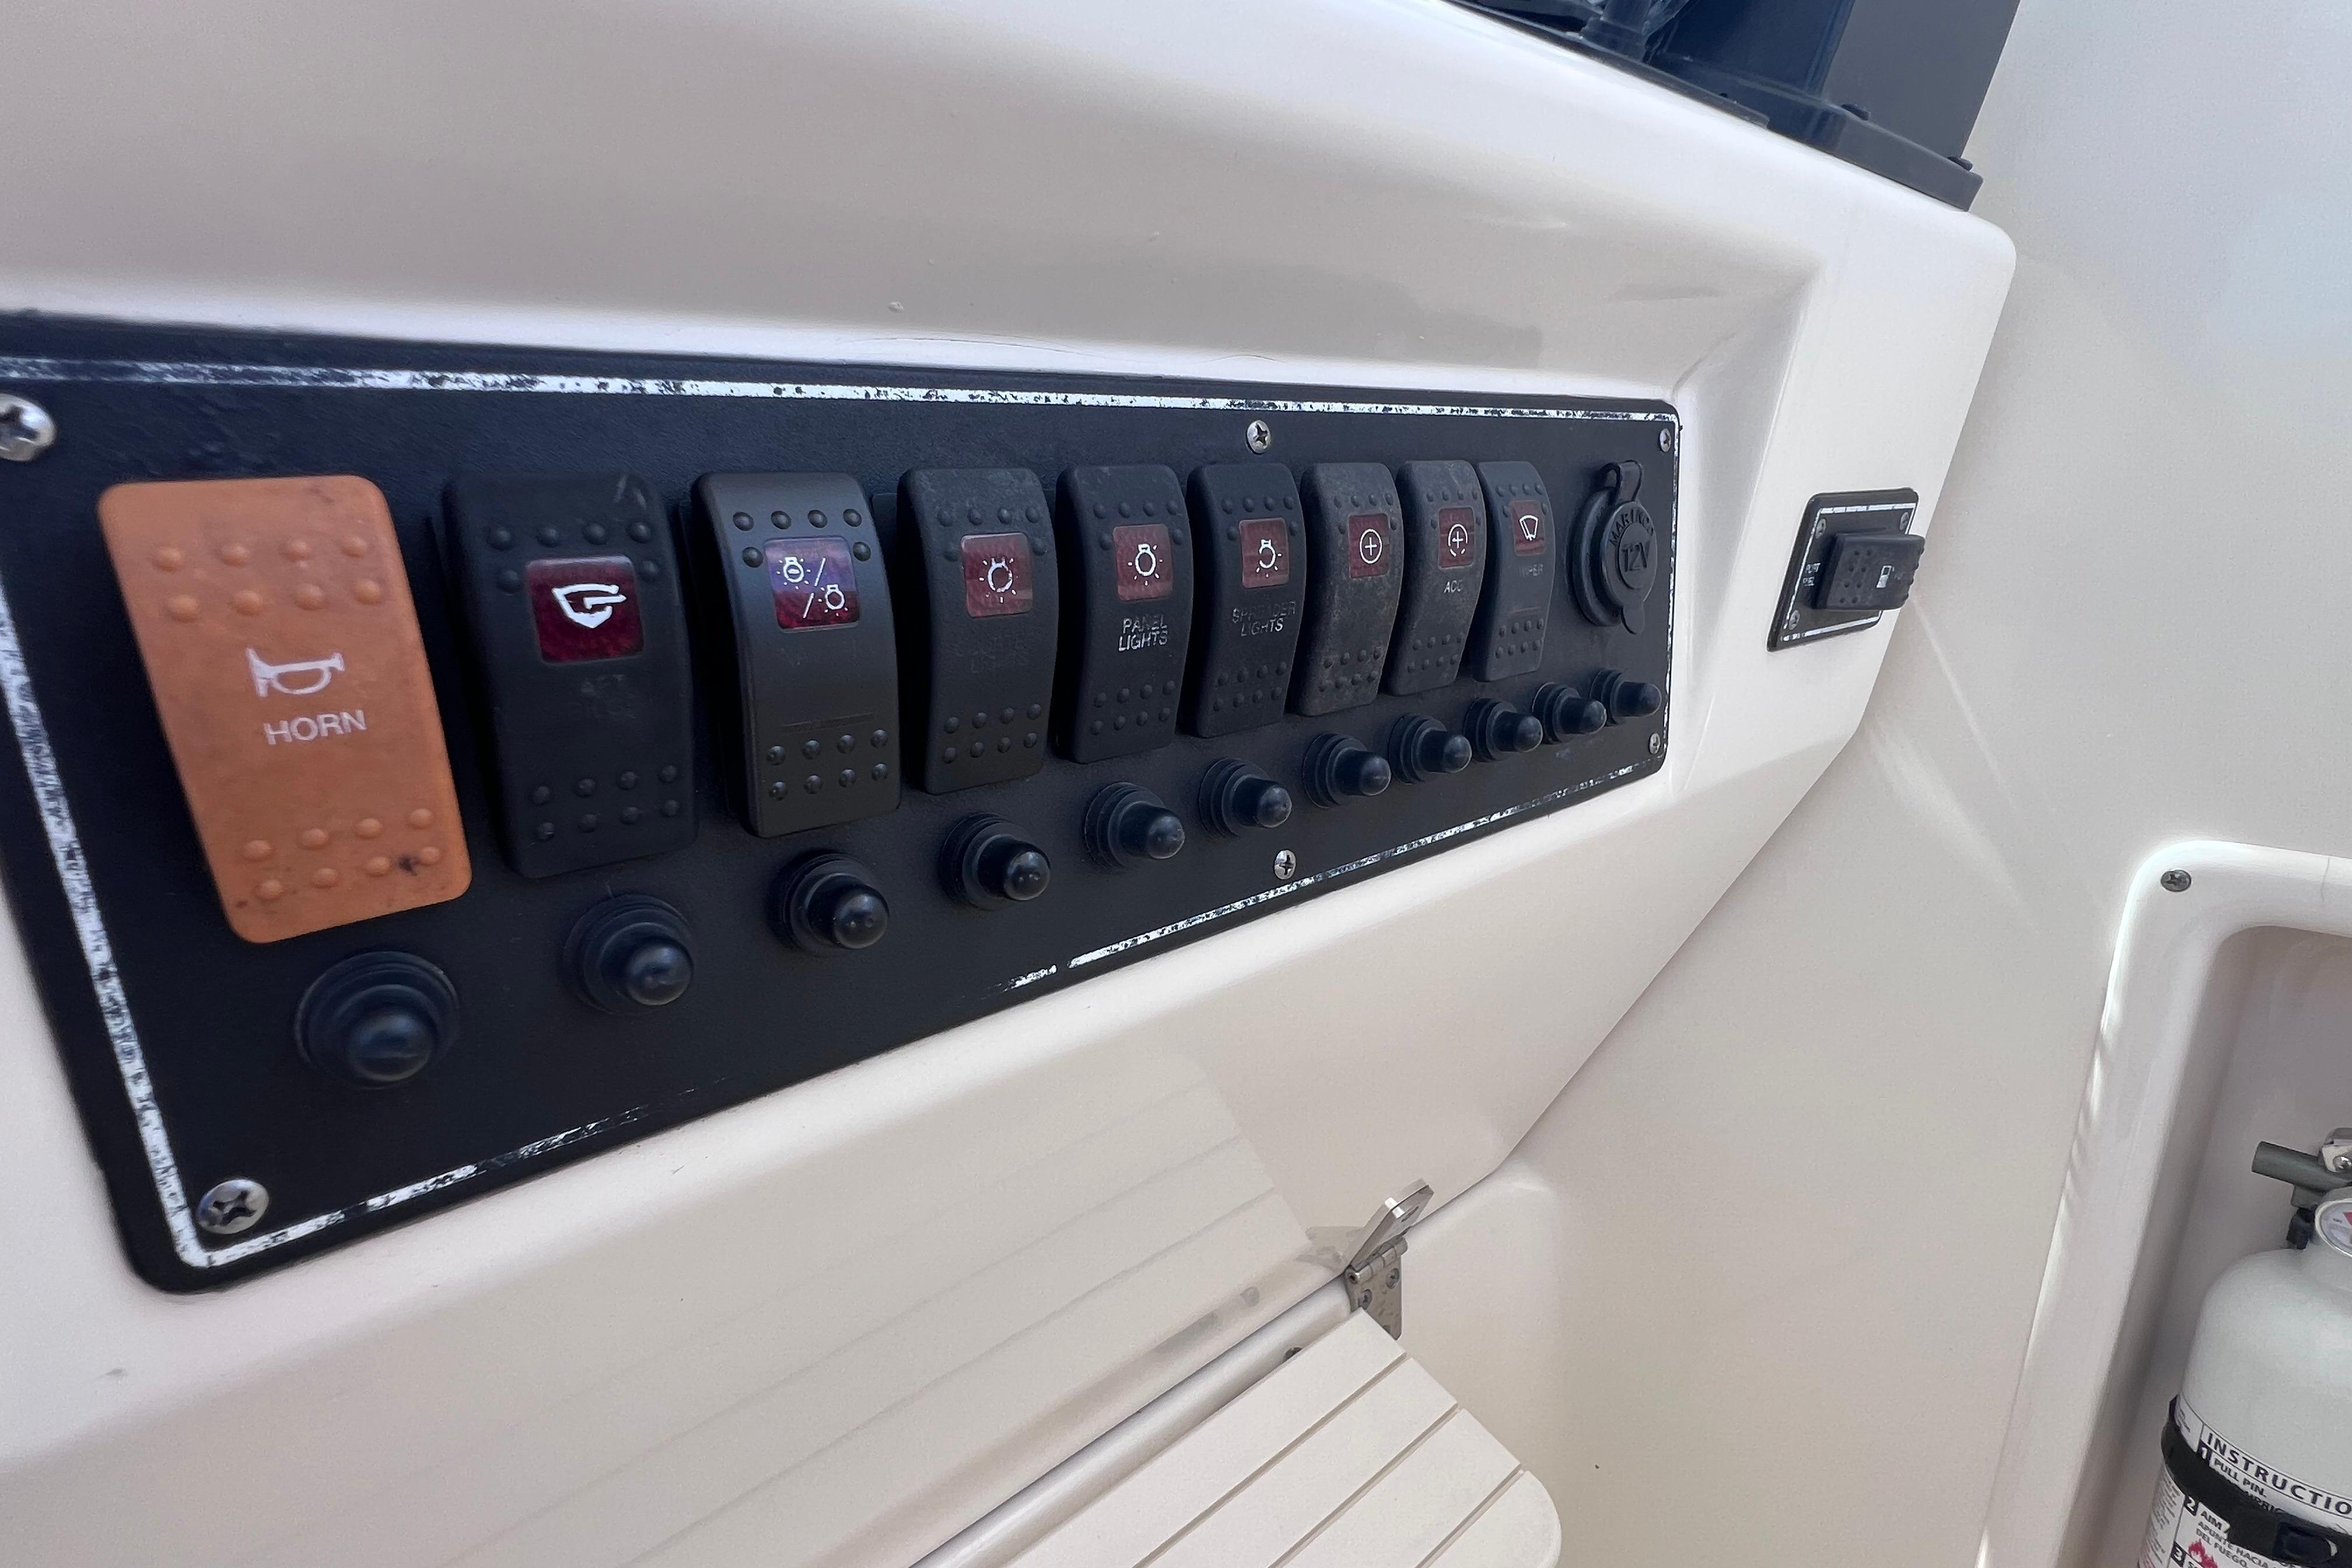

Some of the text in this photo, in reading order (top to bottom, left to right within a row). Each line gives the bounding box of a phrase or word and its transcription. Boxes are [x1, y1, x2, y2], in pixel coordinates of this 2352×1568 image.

[1622, 541, 1651, 572] 12V
[1122, 614, 1168, 634] PANEL
[1241, 617, 1284, 636] LIGHTS
[1118, 631, 1168, 652] LIGHTS
[263, 709, 367, 746] HORN
[2214, 1458, 2239, 1482] PULL
[2242, 1478, 2267, 1498] PIN.
[2186, 1496, 2222, 1530] 2 AIM
[2196, 1528, 2211, 1545] DEL
[2174, 1546, 2183, 1561] 3
